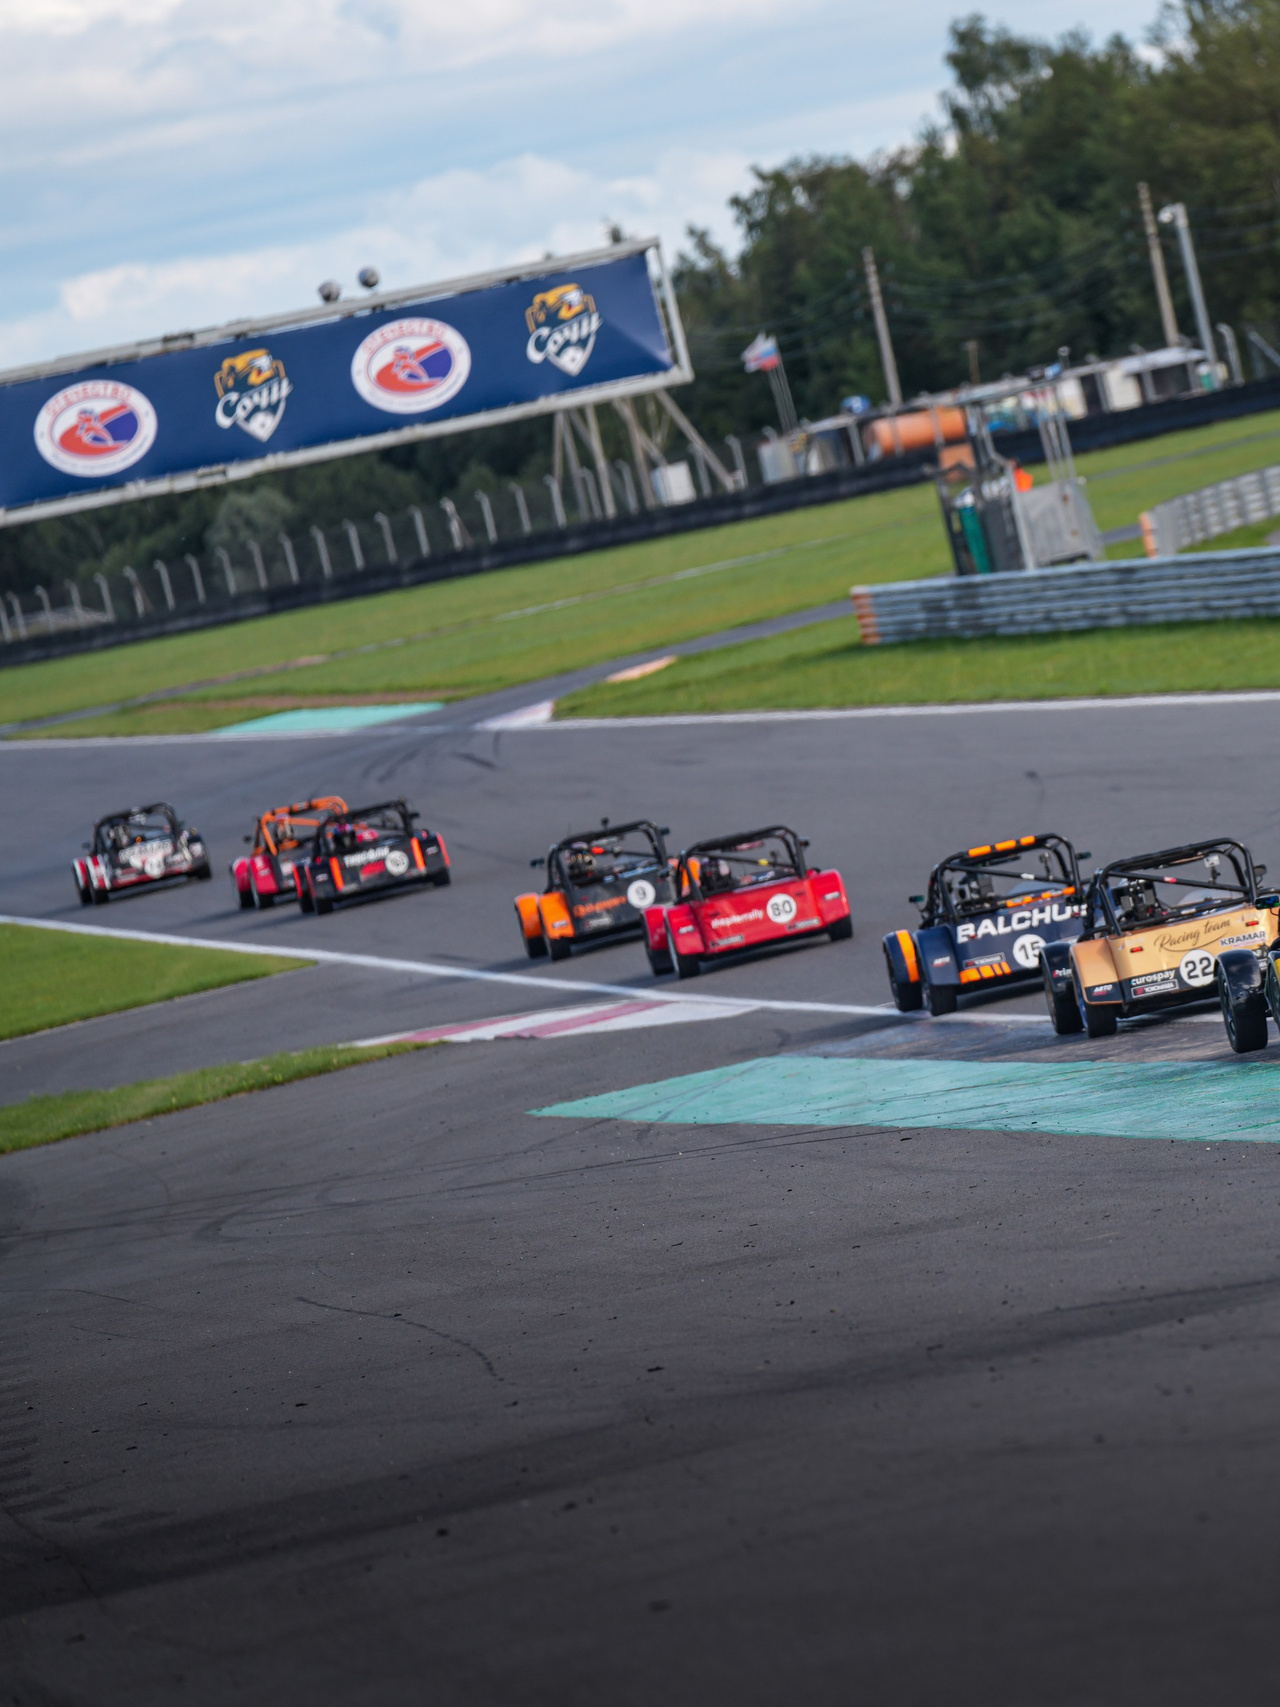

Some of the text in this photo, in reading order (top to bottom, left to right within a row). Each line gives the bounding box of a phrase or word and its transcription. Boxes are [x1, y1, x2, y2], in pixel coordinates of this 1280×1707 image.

[771, 900, 792, 916] 80
[1153, 919, 1231, 953] Racing team
[1220, 931, 1266, 946] KRAMAR
[1185, 956, 1213, 980] 22
